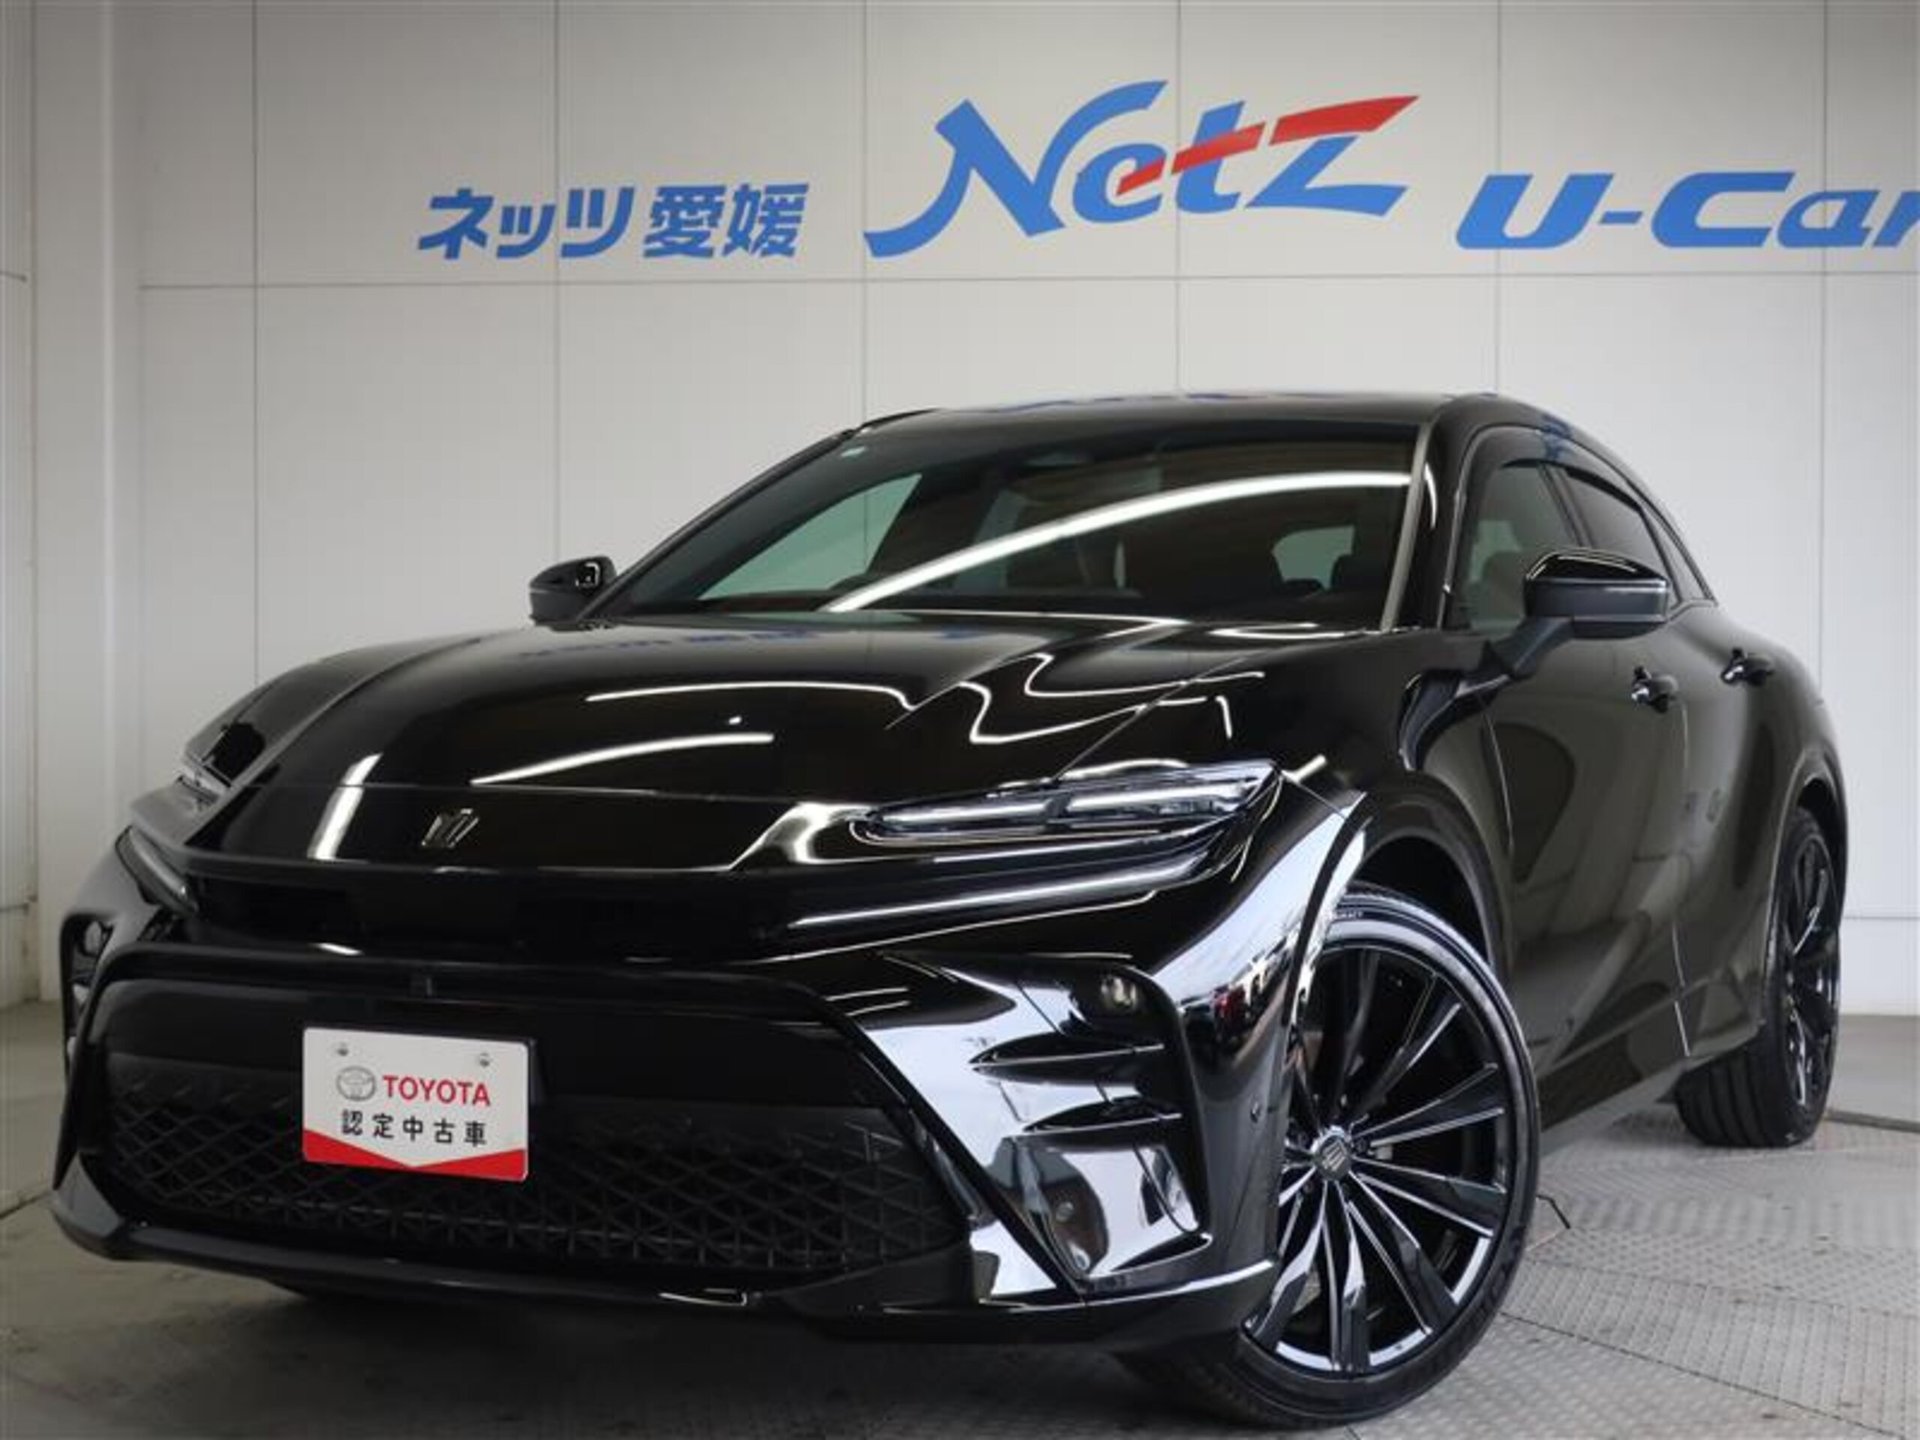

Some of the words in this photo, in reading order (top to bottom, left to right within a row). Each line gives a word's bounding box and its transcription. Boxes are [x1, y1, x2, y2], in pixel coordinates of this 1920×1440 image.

[863, 79, 1420, 258] Netz
[417, 182, 810, 260] ネッツ愛媛
[382, 1074, 491, 1106] TOYOTA
[341, 1108, 488, 1147] 認定中古車
